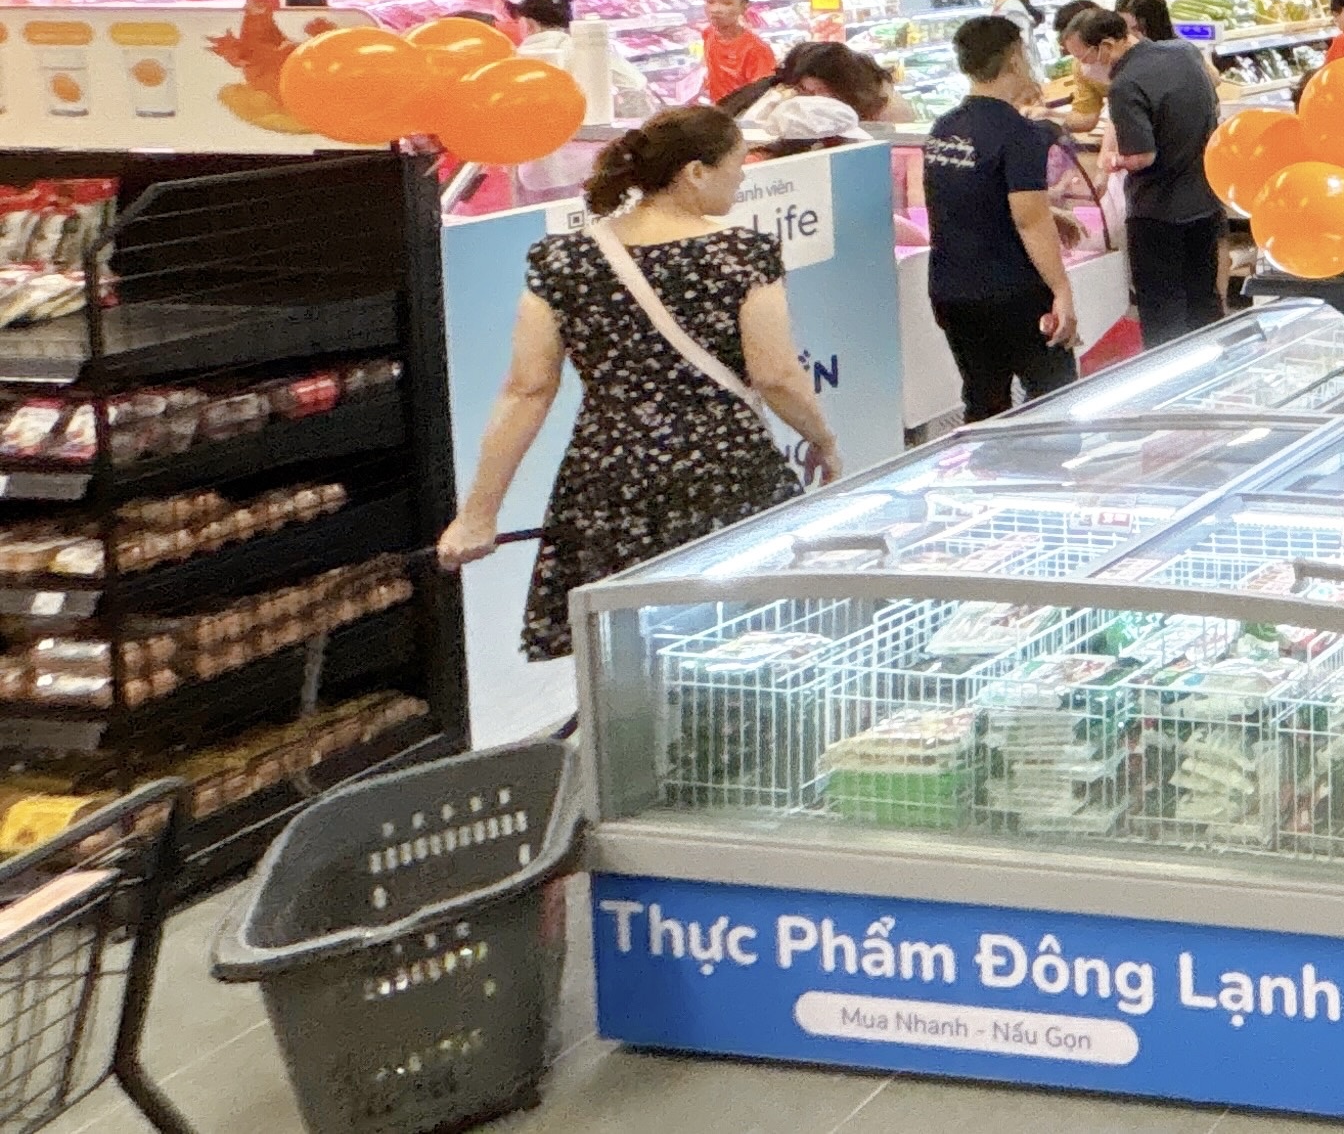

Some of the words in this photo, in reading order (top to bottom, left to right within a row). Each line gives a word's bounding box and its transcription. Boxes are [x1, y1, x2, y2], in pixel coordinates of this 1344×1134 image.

[765, 179, 795, 198] viên
[599, 899, 759, 977] Thực
[776, 914, 957, 985] Phẩm
[973, 933, 1154, 1016] Đông
[1178, 951, 1342, 1028] Lạnh
[840, 1005, 890, 1031] Mua
[895, 1009, 970, 1039] Nhanh
[992, 1020, 1039, 1047] Nấu
[1045, 1026, 1093, 1053] Gọn
